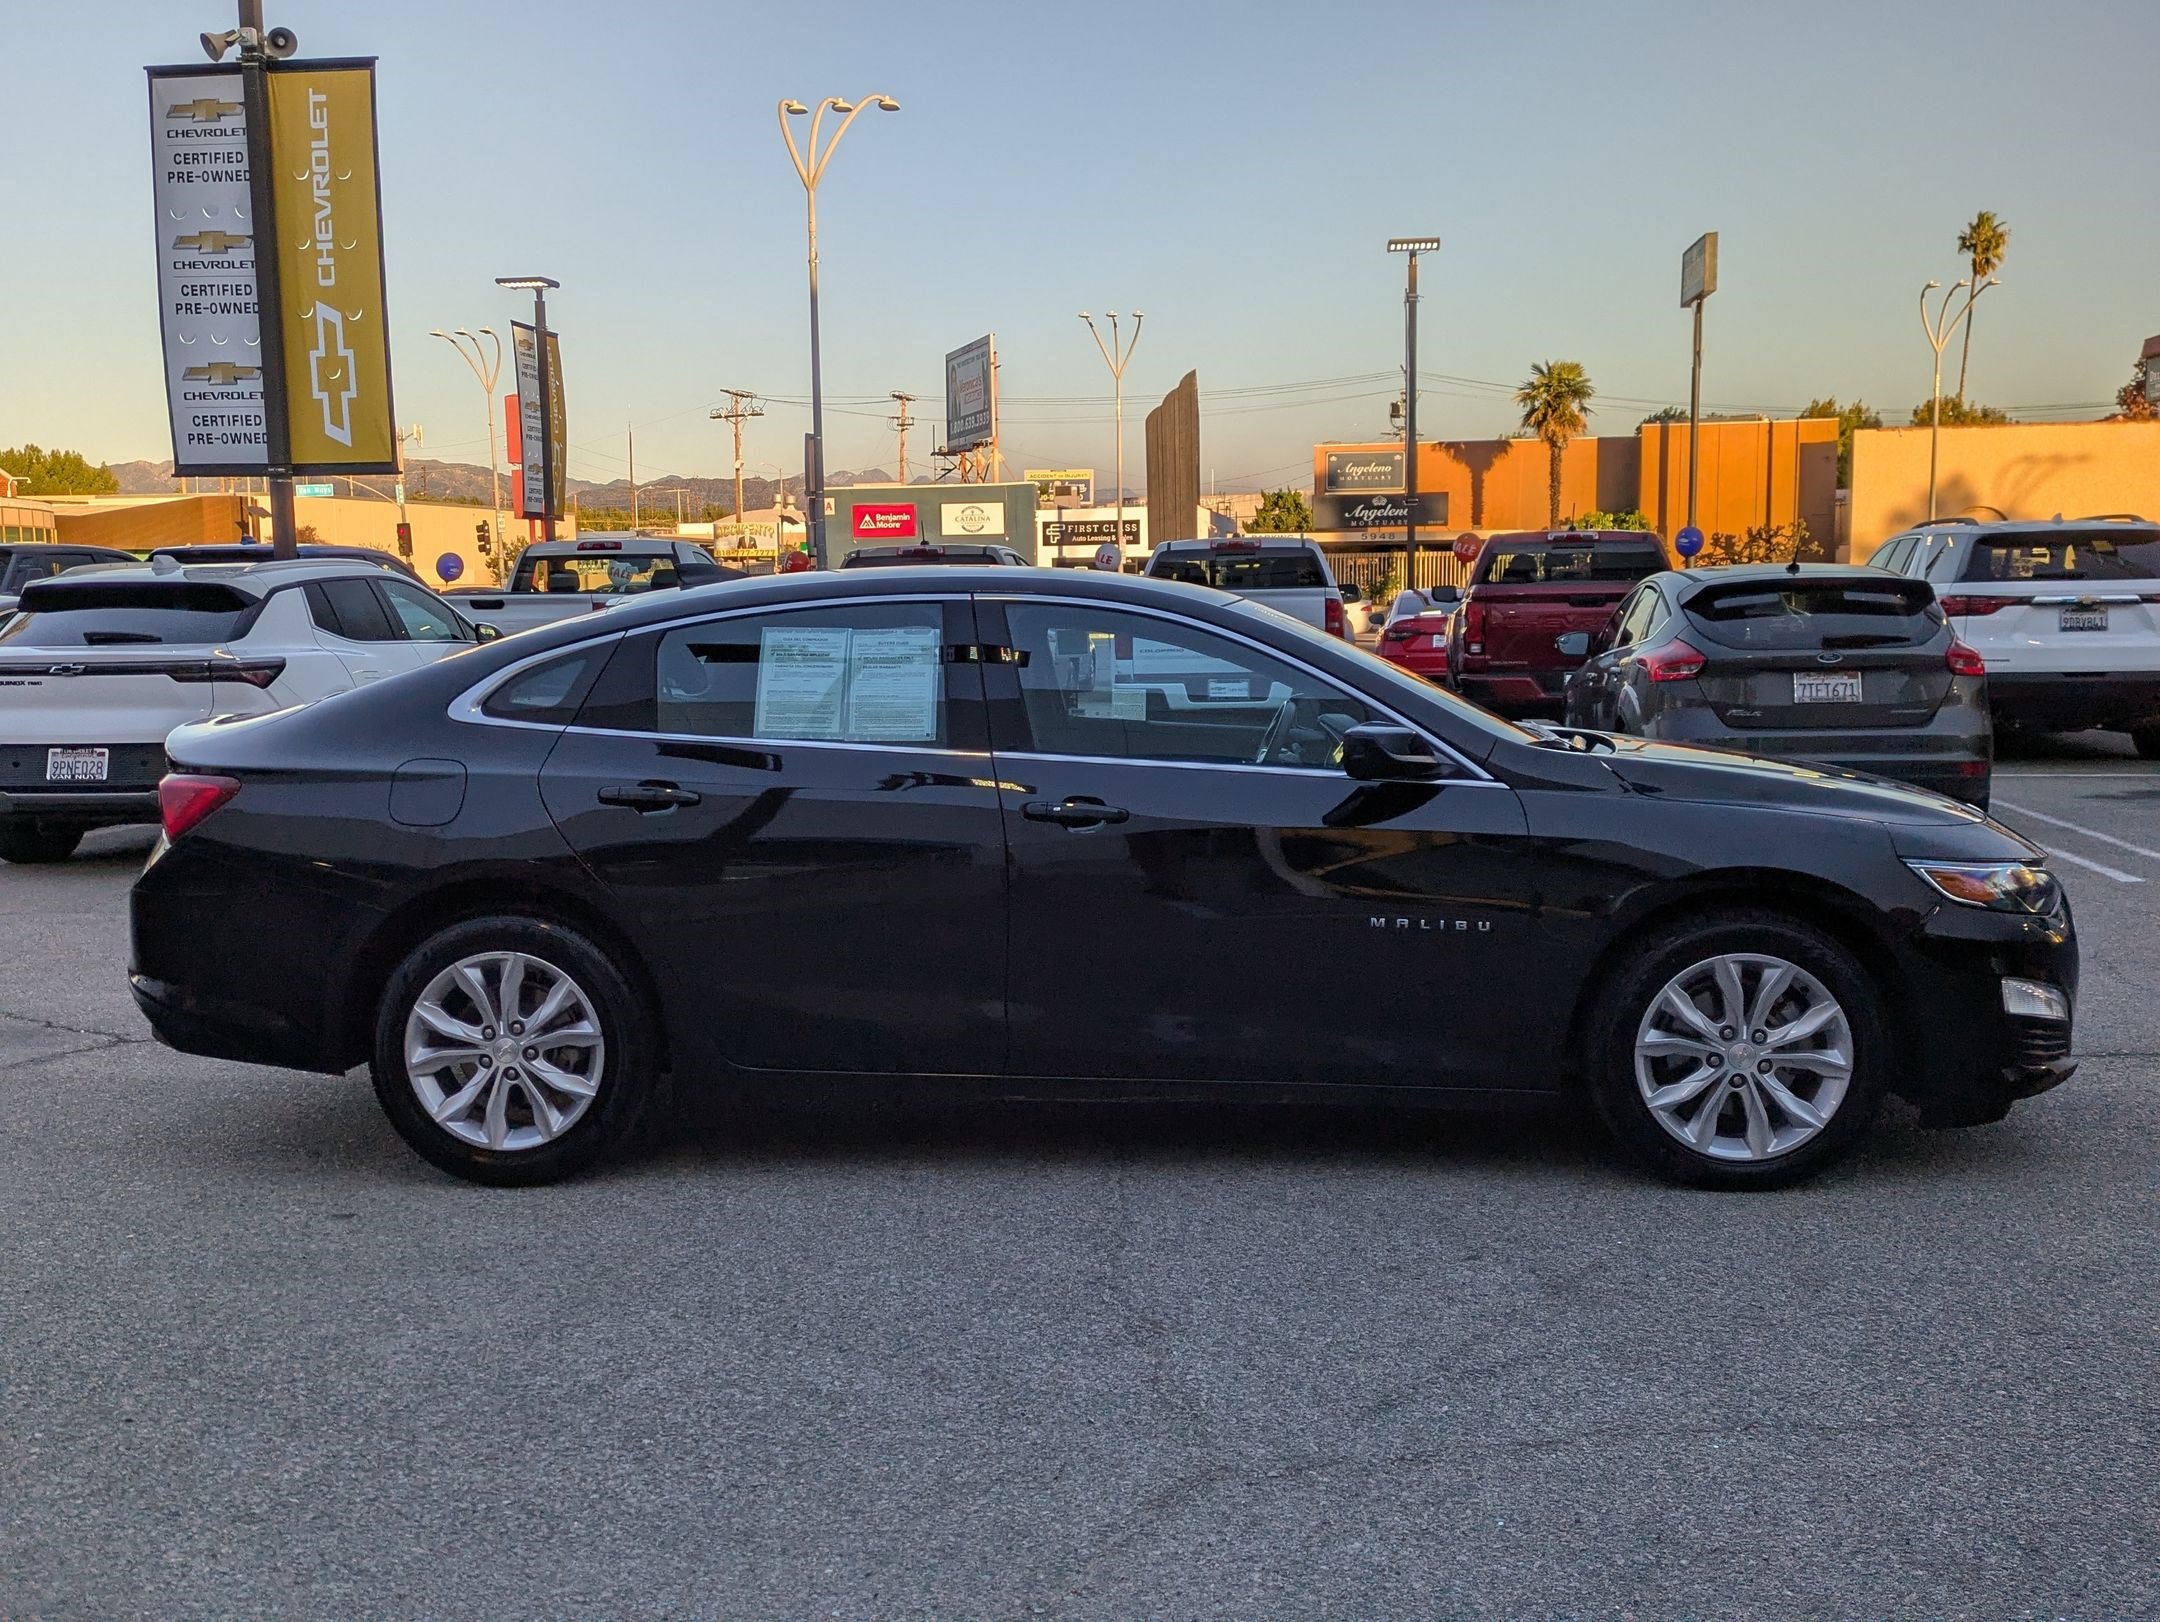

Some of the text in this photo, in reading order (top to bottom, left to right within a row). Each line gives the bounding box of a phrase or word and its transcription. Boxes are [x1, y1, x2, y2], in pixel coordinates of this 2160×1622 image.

[166, 127, 246, 138] CHEVROLET
[173, 151, 244, 165] CERTIFIED
[168, 169, 250, 184] PRE-OWNED
[308, 88, 336, 286] CHEVROLET
[173, 260, 256, 270] CHEVROLET
[180, 284, 252, 297] CERTIFIED
[175, 302, 259, 315] PRE-OWNED
[183, 391, 264, 402] CHEVROLET
[192, 414, 262, 427] CERTIFIED
[187, 431, 268, 446] PRE-OWNED
[1338, 462, 1392, 476] Angeleno
[1102, 524, 1138, 532] CLSS
[1370, 918, 1490, 930] MALIBU
